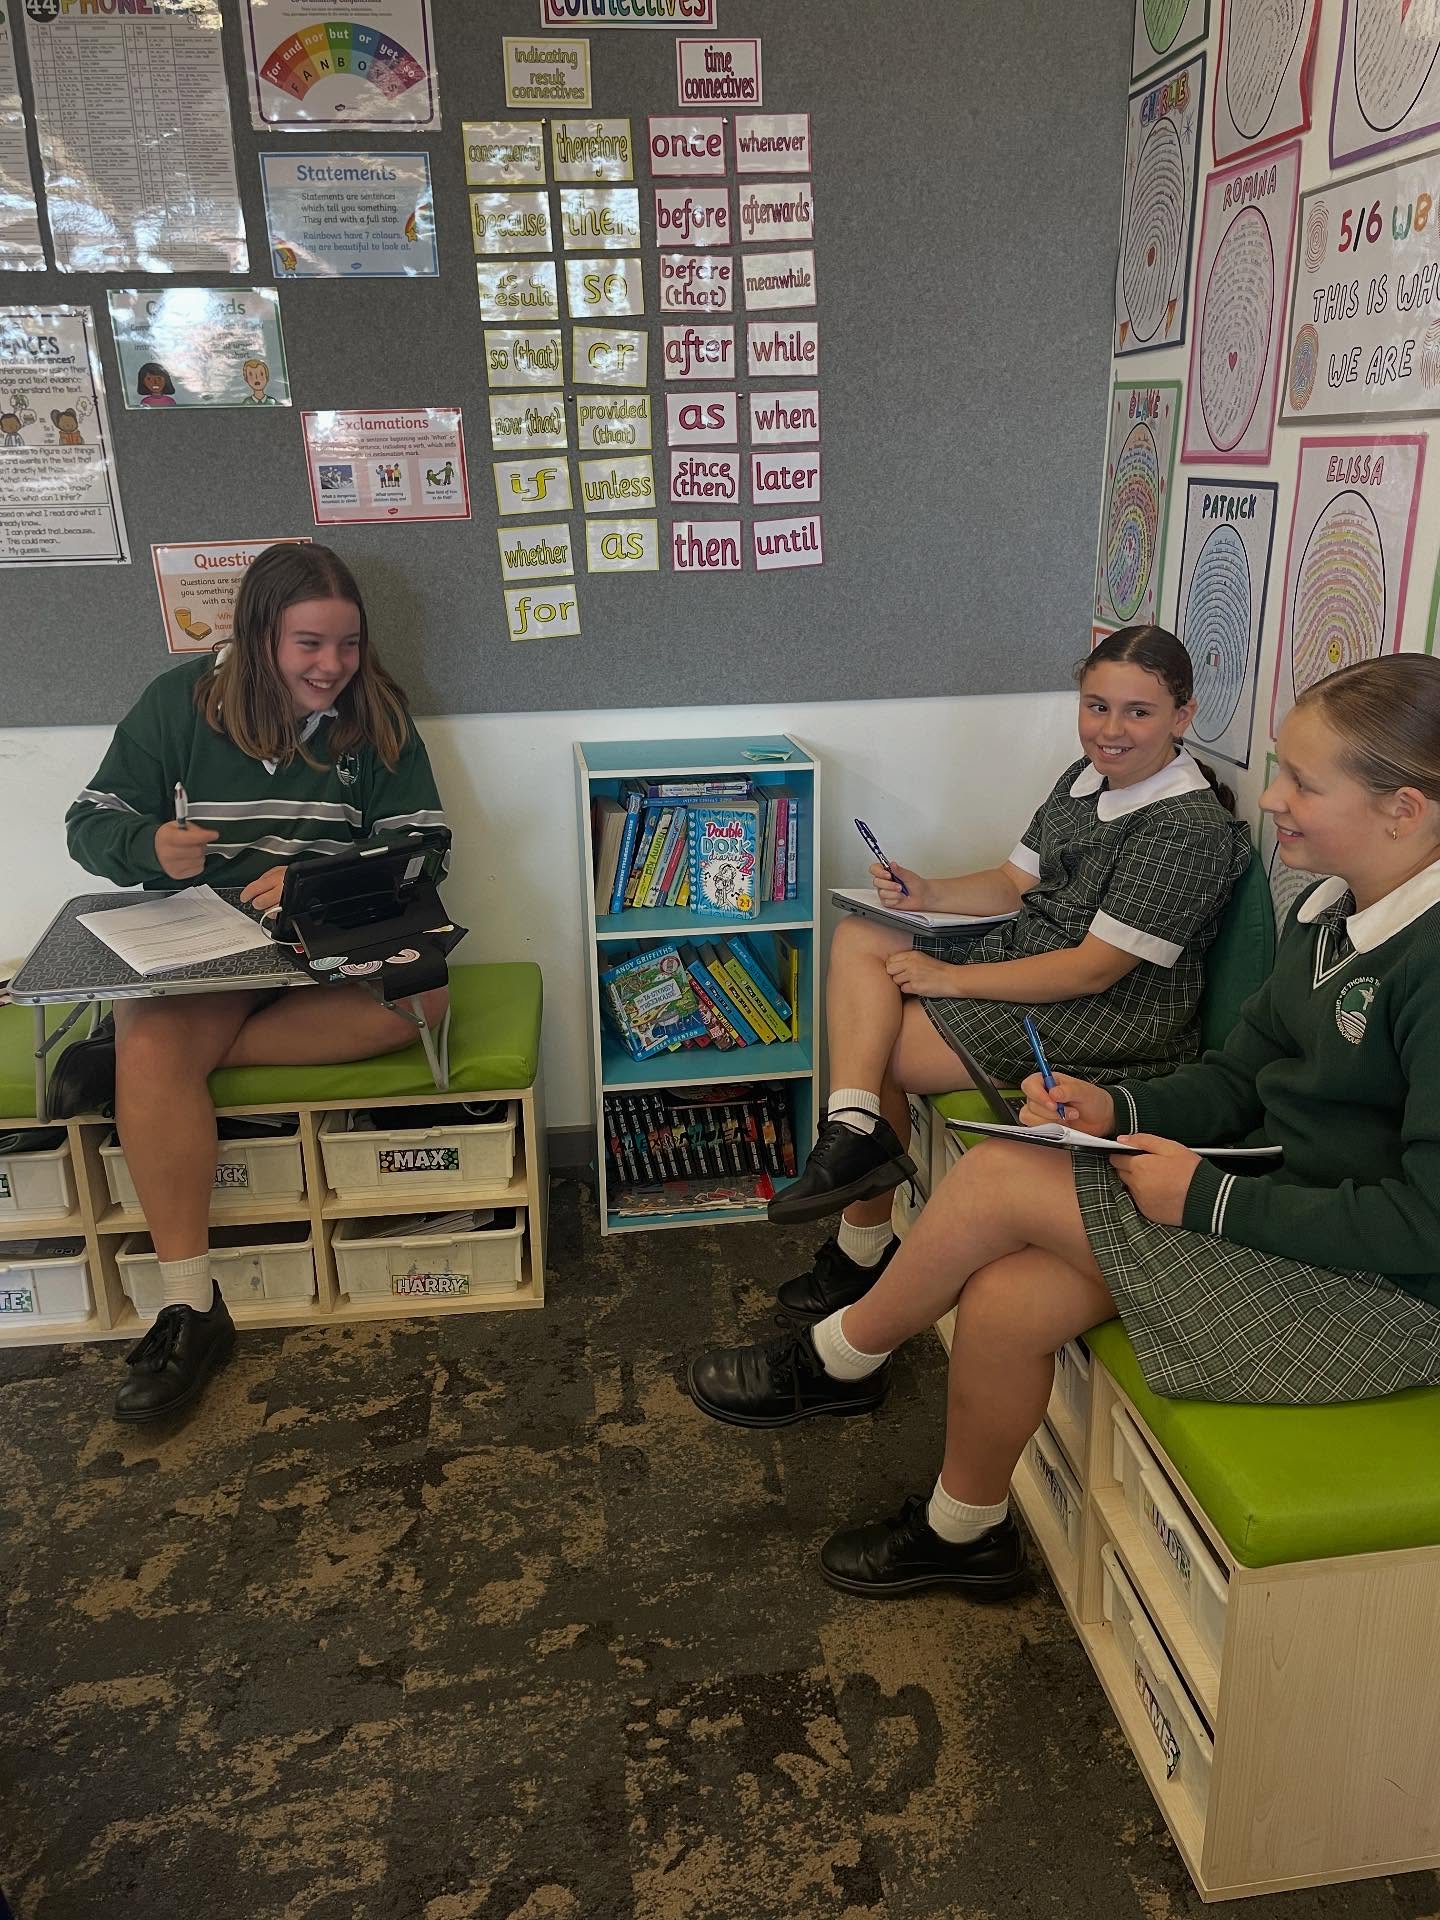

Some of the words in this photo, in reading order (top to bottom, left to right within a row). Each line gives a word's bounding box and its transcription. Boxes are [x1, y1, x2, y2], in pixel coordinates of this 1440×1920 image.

[266, 61, 282, 83] for
[283, 40, 303, 61] and
[304, 32, 325, 46] nor
[329, 28, 350, 39] but
[358, 34, 372, 44] or
[379, 43, 399, 60] yet
[403, 65, 416, 78] so
[514, 46, 578, 70] indicating
[704, 46, 734, 73] time
[529, 68, 566, 87] result
[684, 71, 755, 100] connectives
[512, 85, 585, 100] connectives
[556, 124, 628, 177] therefore
[652, 134, 722, 158] once
[738, 130, 805, 152] whenever
[297, 165, 397, 181] Statements
[302, 192, 344, 200] Statements
[361, 193, 396, 201] sentences
[1223, 165, 1277, 211] ROMINA
[301, 204, 325, 212] which
[327, 204, 339, 212] tell
[341, 205, 355, 214] you
[357, 204, 399, 214] something.
[303, 216, 322, 225] They
[366, 215, 380, 225] full
[381, 216, 400, 225] stop.
[474, 203, 547, 237] because
[657, 198, 727, 239] before
[742, 192, 810, 235] afterwards
[303, 232, 342, 240] Rainbows
[344, 232, 363, 240] have
[1338, 200, 1383, 252] 5/6
[333, 242, 369, 253] beautiful
[381, 242, 399, 250] look
[400, 242, 411, 250] at.
[662, 258, 731, 286] before
[746, 268, 811, 292] meanwhile
[583, 273, 628, 304] so
[666, 284, 726, 307] (that)
[1313, 280, 1359, 323] THIS
[1367, 274, 1388, 315] IS
[490, 350, 509, 369] so
[513, 339, 560, 372] (that)
[588, 342, 634, 371] or
[665, 329, 733, 375] after
[753, 331, 816, 362] while
[1328, 347, 1362, 388] WE
[1366, 340, 1415, 385] ARE
[11, 386, 50, 394] understand
[52, 385, 64, 393] the
[337, 417, 429, 430] Exclamations
[495, 417, 522, 435] now
[525, 407, 562, 436] (that)
[580, 399, 648, 426] provided
[679, 401, 726, 430] as
[755, 400, 817, 430] when
[593, 424, 636, 445] (that)
[678, 457, 731, 478] since
[756, 462, 818, 491] later
[1326, 455, 1385, 486] ELISSA
[510, 467, 558, 501] if
[584, 470, 652, 501] unless
[673, 472, 736, 499] (then)
[1202, 494, 1257, 520] PATRICK
[9, 546, 19, 555] My
[601, 532, 644, 560] as
[675, 525, 740, 568] then
[757, 522, 819, 557] until
[504, 541, 569, 569] whether
[180, 579, 216, 587] Questions
[181, 590, 195, 598] you
[197, 587, 234, 596] something
[513, 597, 575, 635] for
[705, 822, 743, 838] Double
[702, 838, 751, 854] DORK
[739, 852, 755, 876] 2
[615, 961, 634, 975] ANDY
[636, 946, 674, 965] GRIFFITHS
[1347, 976, 1374, 989] THOMAS
[393, 1149, 447, 1168] MAX
[397, 1277, 465, 1295] HARRY
